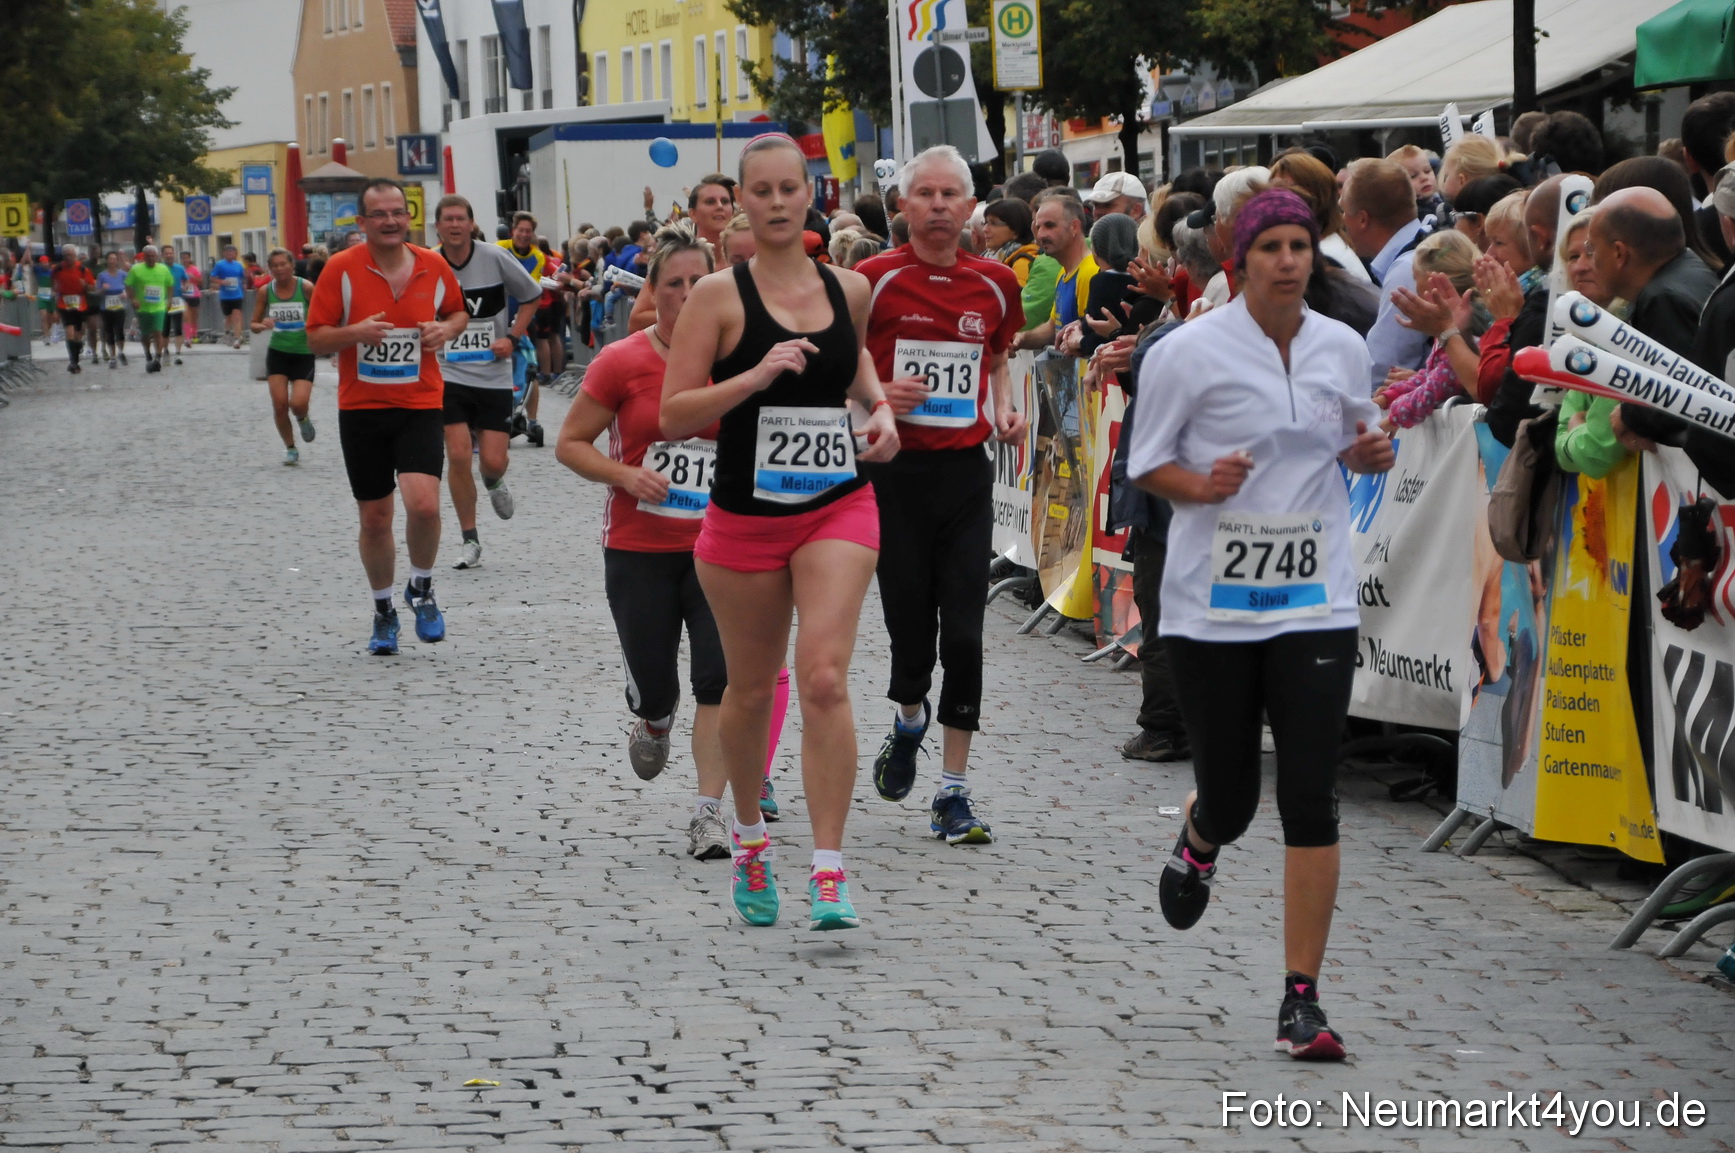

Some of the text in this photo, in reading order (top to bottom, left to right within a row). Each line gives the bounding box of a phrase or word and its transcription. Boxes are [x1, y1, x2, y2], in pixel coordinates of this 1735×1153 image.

[625, 9, 649, 36] HOTEL
[964, 31, 985, 39] Gasse
[6, 206, 21, 227] D
[70, 223, 90, 233] TAXI
[188, 223, 210, 233] TAXI
[450, 332, 491, 350] 2445
[363, 341, 415, 363] 2922
[897, 348, 968, 359] PARTL Neumarkt
[904, 361, 972, 394] 2613
[1608, 363, 1681, 409] BMW
[923, 402, 952, 414] Horst
[761, 417, 837, 426] PARTL Neumarkt
[768, 431, 847, 467] 2285
[781, 476, 835, 491] Melanie
[669, 493, 700, 508] Petra
[1218, 522, 1309, 535] PARTL Neumarkt
[1224, 539, 1317, 580] 2748
[1249, 591, 1289, 607] Silvia
[1551, 625, 1586, 647] Pflaster
[1367, 637, 1453, 692] Neumarkt
[1546, 689, 1600, 713] Palisaden
[1545, 721, 1585, 744] Stufen
